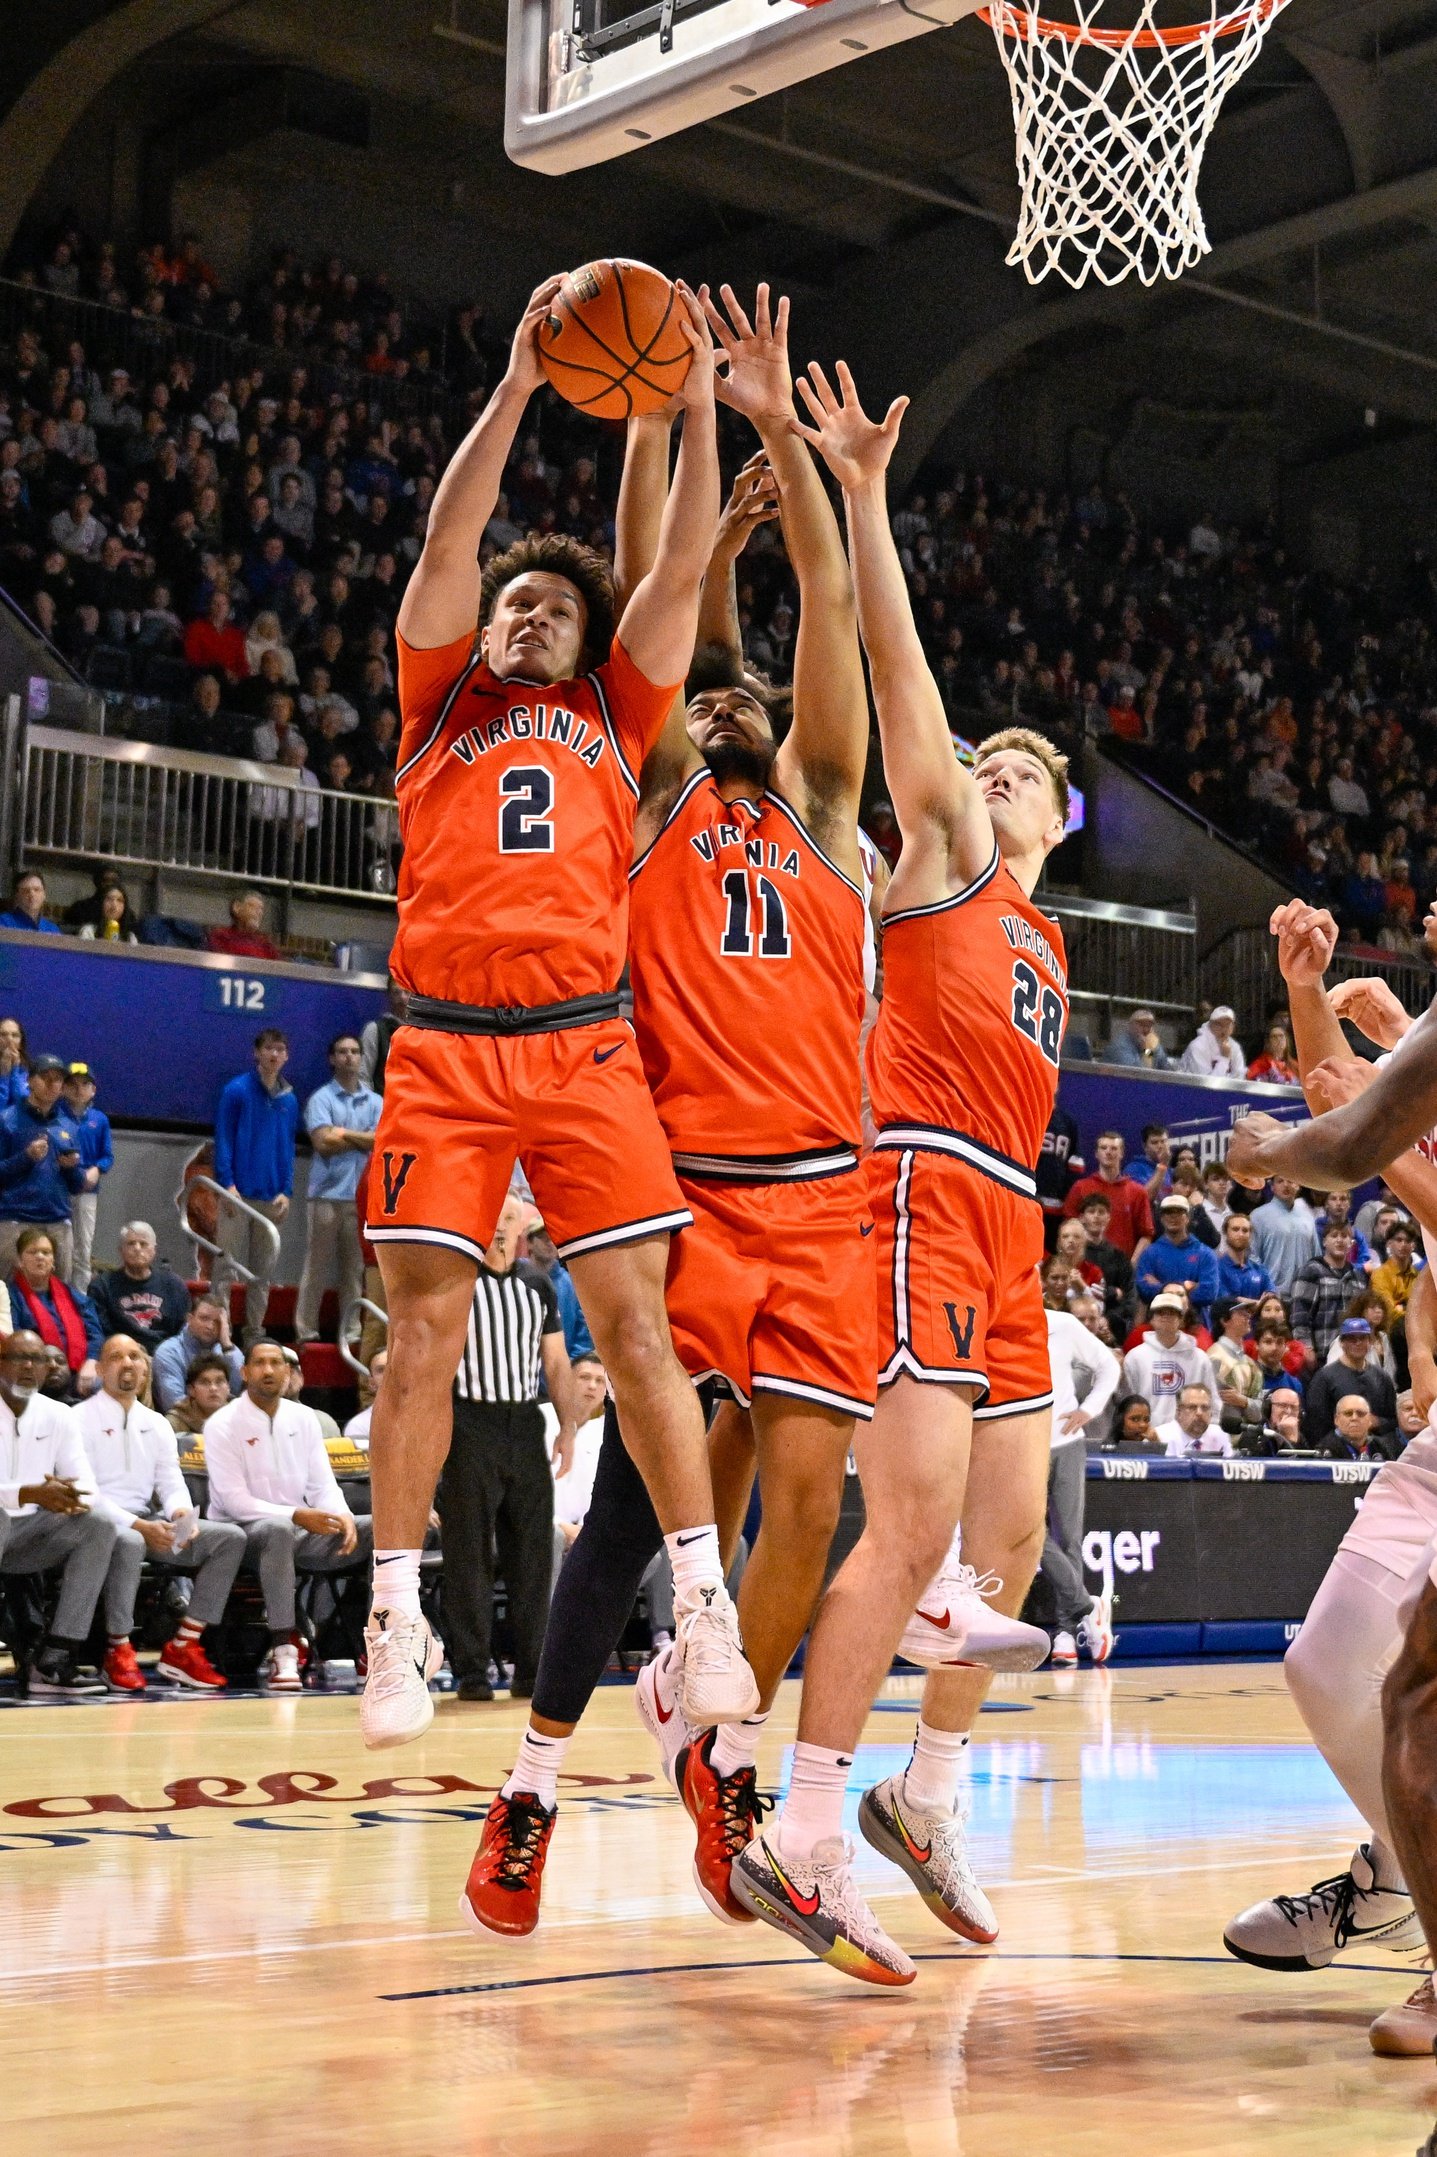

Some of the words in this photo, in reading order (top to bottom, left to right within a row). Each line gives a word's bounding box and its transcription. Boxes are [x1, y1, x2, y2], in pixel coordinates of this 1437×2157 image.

[452, 704, 605, 769] VIRGINIA
[498, 764, 555, 855] 2
[720, 868, 791, 959] 11
[999, 915, 1069, 1000] VIRGINI
[220, 977, 265, 1010] 112
[1011, 958, 1064, 1070] 28
[1042, 1132, 1069, 1161] SA
[381, 1149, 419, 1216] V
[941, 1301, 977, 1361] V
[1103, 1460, 1148, 1479] UTSW
[1222, 1462, 1265, 1480] UTSW
[1332, 1464, 1371, 1482] UTSW
[1082, 1530, 1160, 1601] ger
